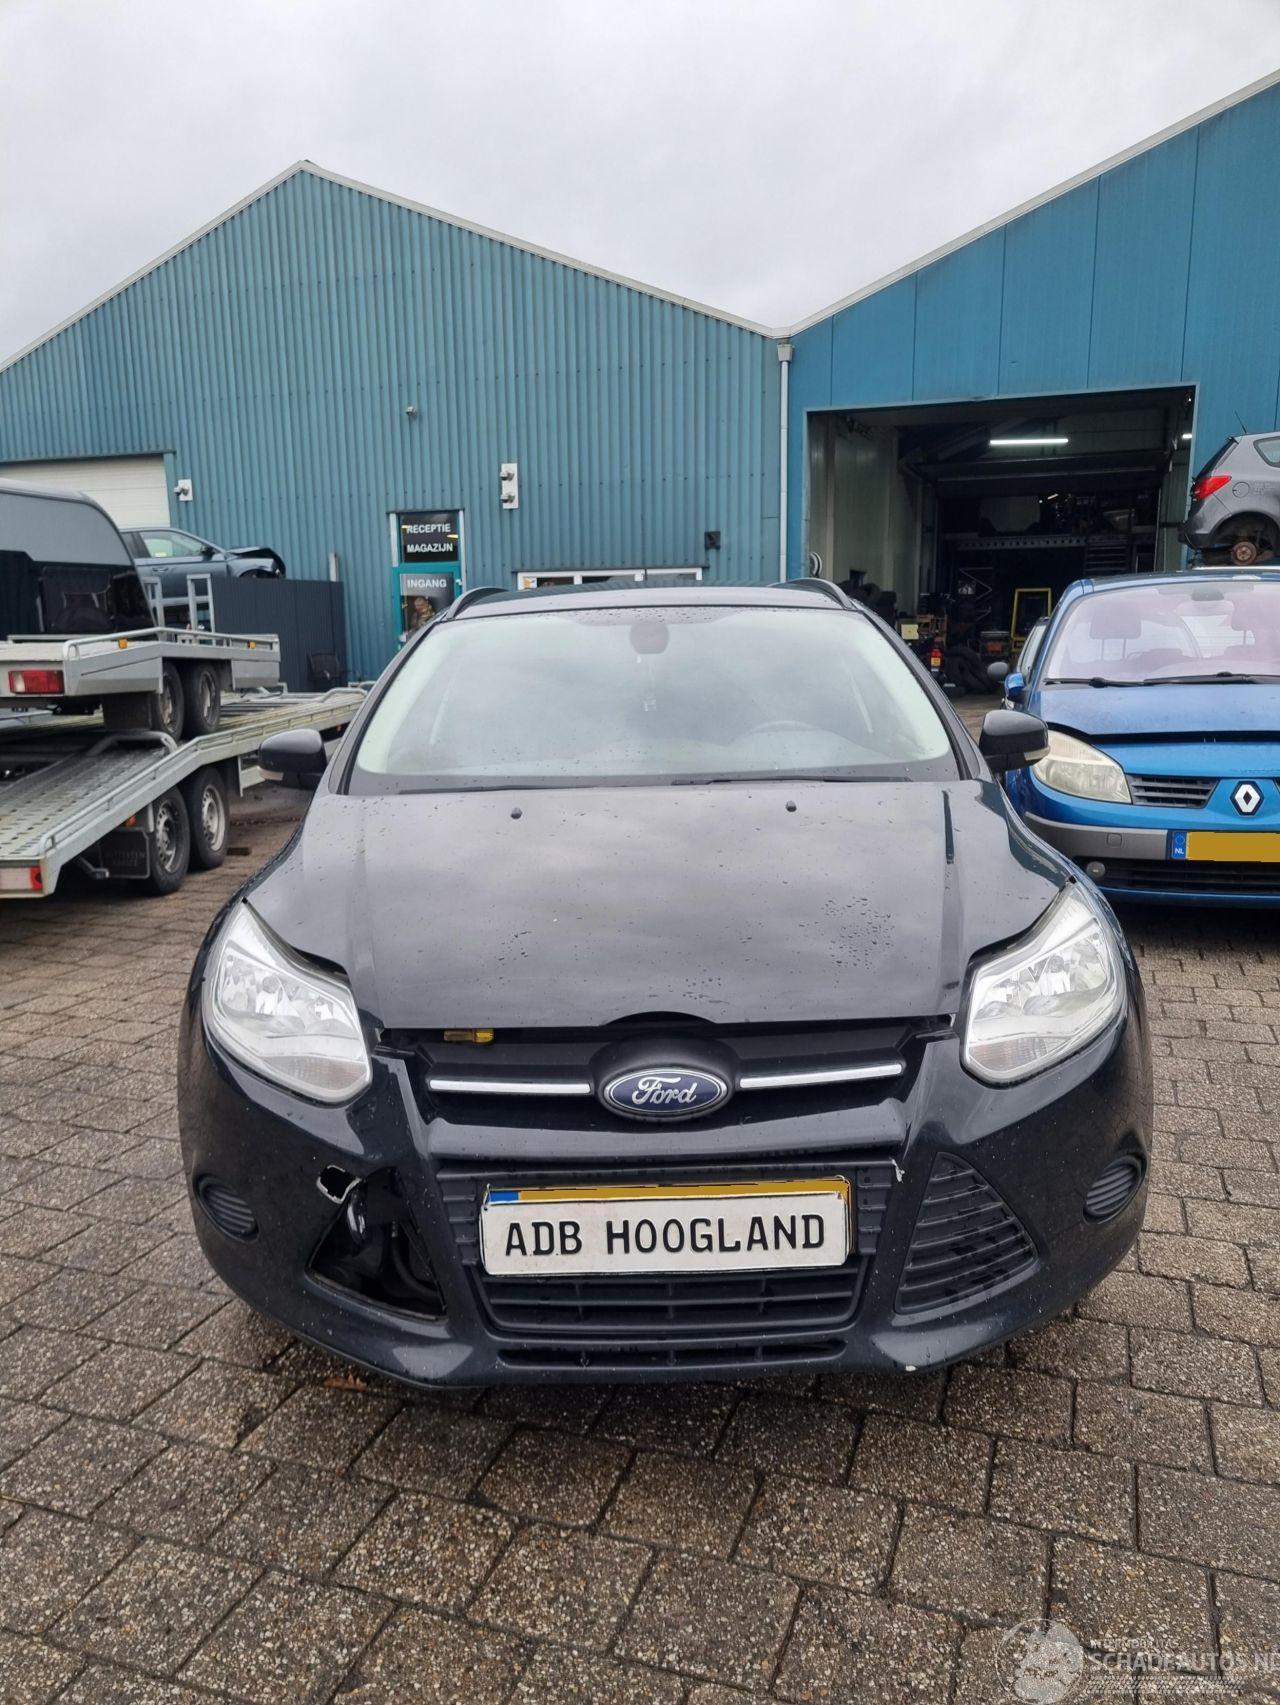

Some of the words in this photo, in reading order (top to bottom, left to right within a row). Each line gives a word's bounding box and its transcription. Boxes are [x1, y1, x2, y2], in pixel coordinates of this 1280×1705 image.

[406, 523, 451, 534] RECEPTIE
[406, 543, 453, 553] MAGAZIJN
[406, 579, 447, 588] INGANG
[1174, 847, 1185, 855] NL
[631, 1076, 698, 1105] Ford
[606, 1213, 825, 1255] HOOGLAND
